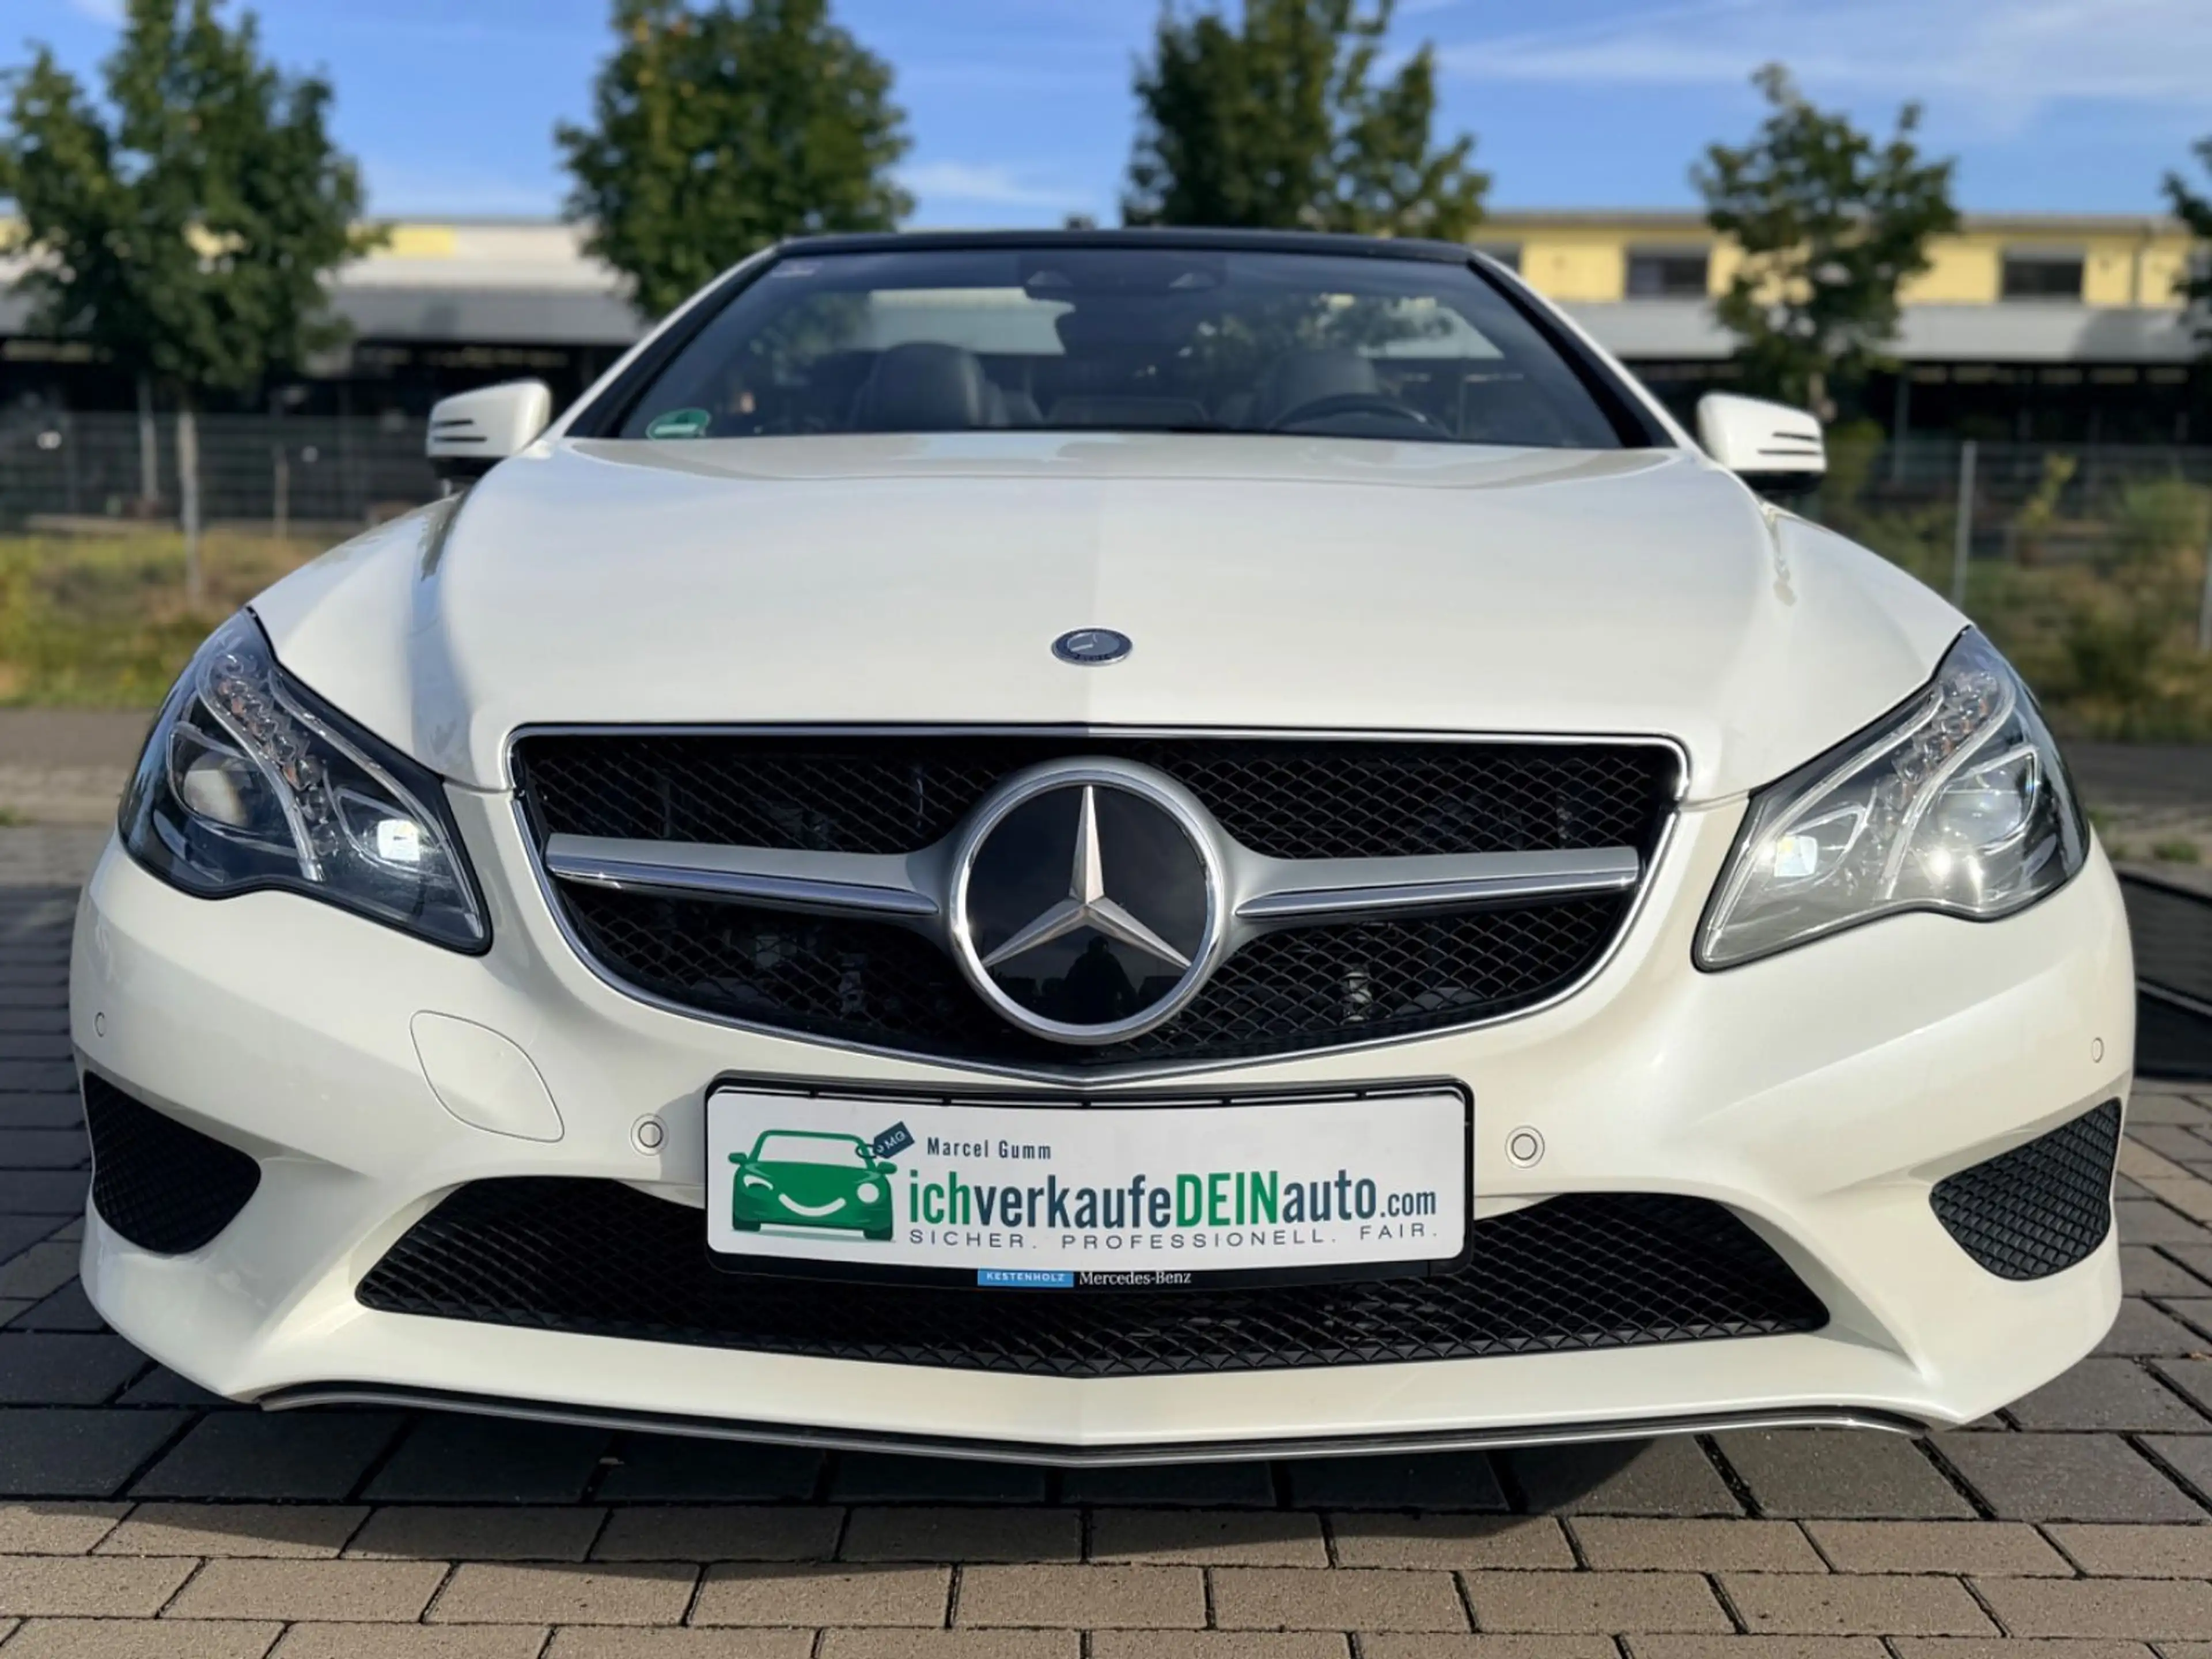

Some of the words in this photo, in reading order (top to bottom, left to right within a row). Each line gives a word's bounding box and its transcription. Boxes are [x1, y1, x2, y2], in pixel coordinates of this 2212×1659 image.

[927, 1137, 988, 1157] Marcel
[998, 1139, 1052, 1160] Gumm
[910, 1169, 1437, 1229] ichverkaufeDEINauto.com
[910, 1229, 1037, 1249] SICHER.
[1061, 1230, 1336, 1249] PROFESSIONELL.
[1360, 1222, 1438, 1241] FAIR.
[986, 1271, 1065, 1282] KESTENHOLZ
[1079, 1270, 1192, 1286] Mercedes-Benz
